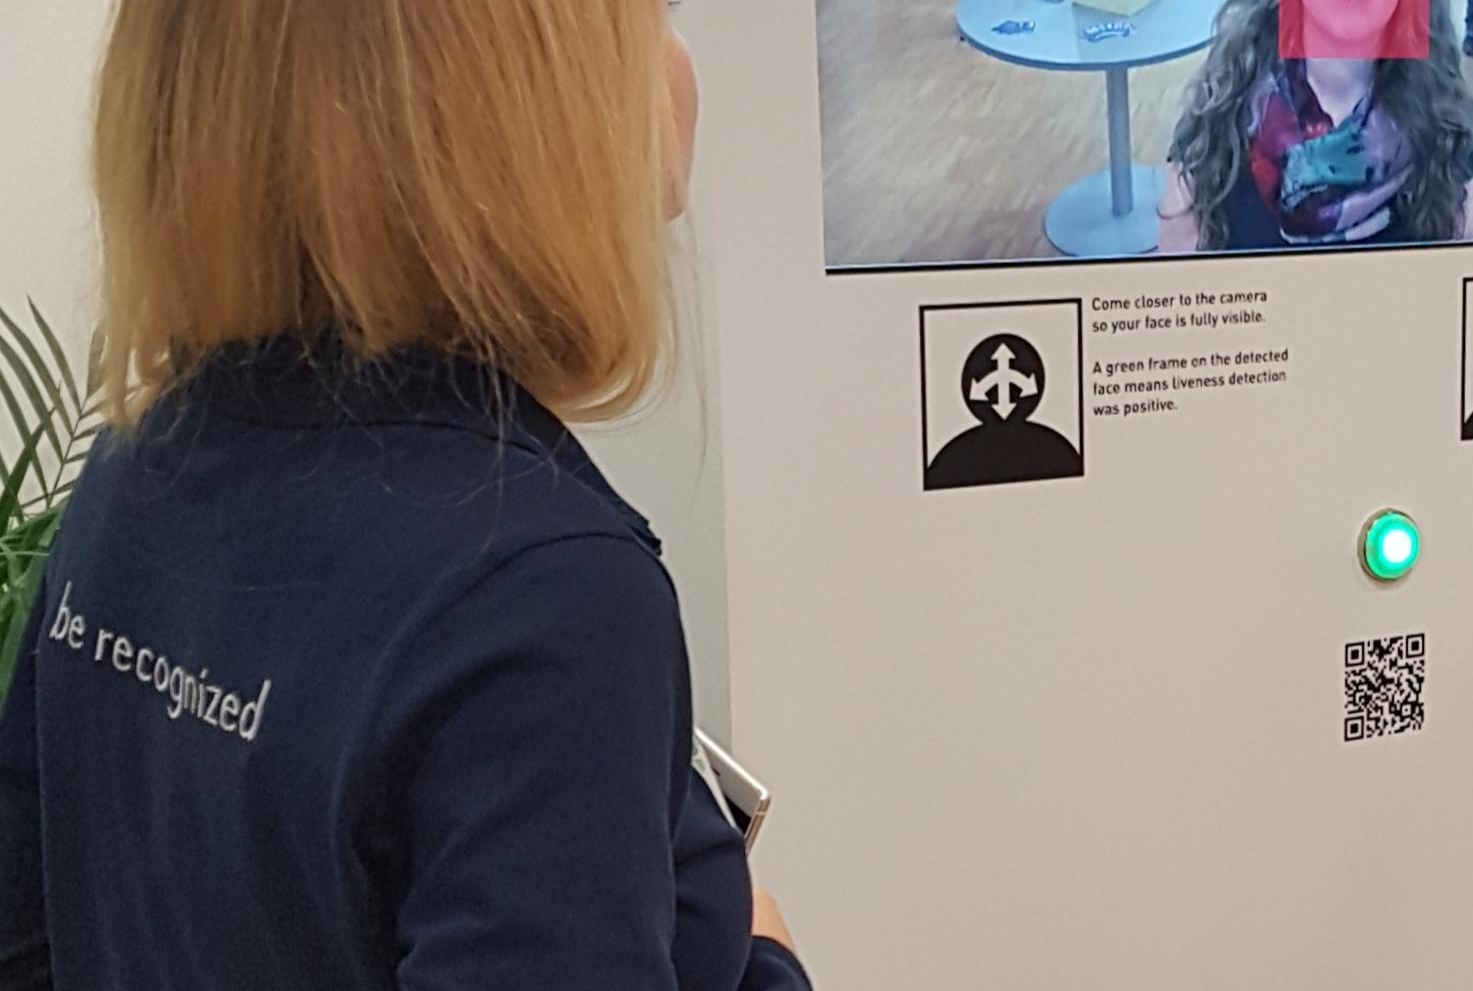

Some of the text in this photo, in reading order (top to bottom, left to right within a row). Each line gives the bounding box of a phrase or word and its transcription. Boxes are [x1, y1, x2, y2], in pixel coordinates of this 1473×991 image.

[1092, 292, 1267, 311] Come closer to the camera
[1092, 310, 1266, 334] so your face is fully visible.
[1092, 348, 1288, 377] A green frame on the detected
[1093, 370, 1286, 396] face means liveness detection
[1093, 398, 1178, 417] was positive.
[50, 580, 271, 741] be recognized
